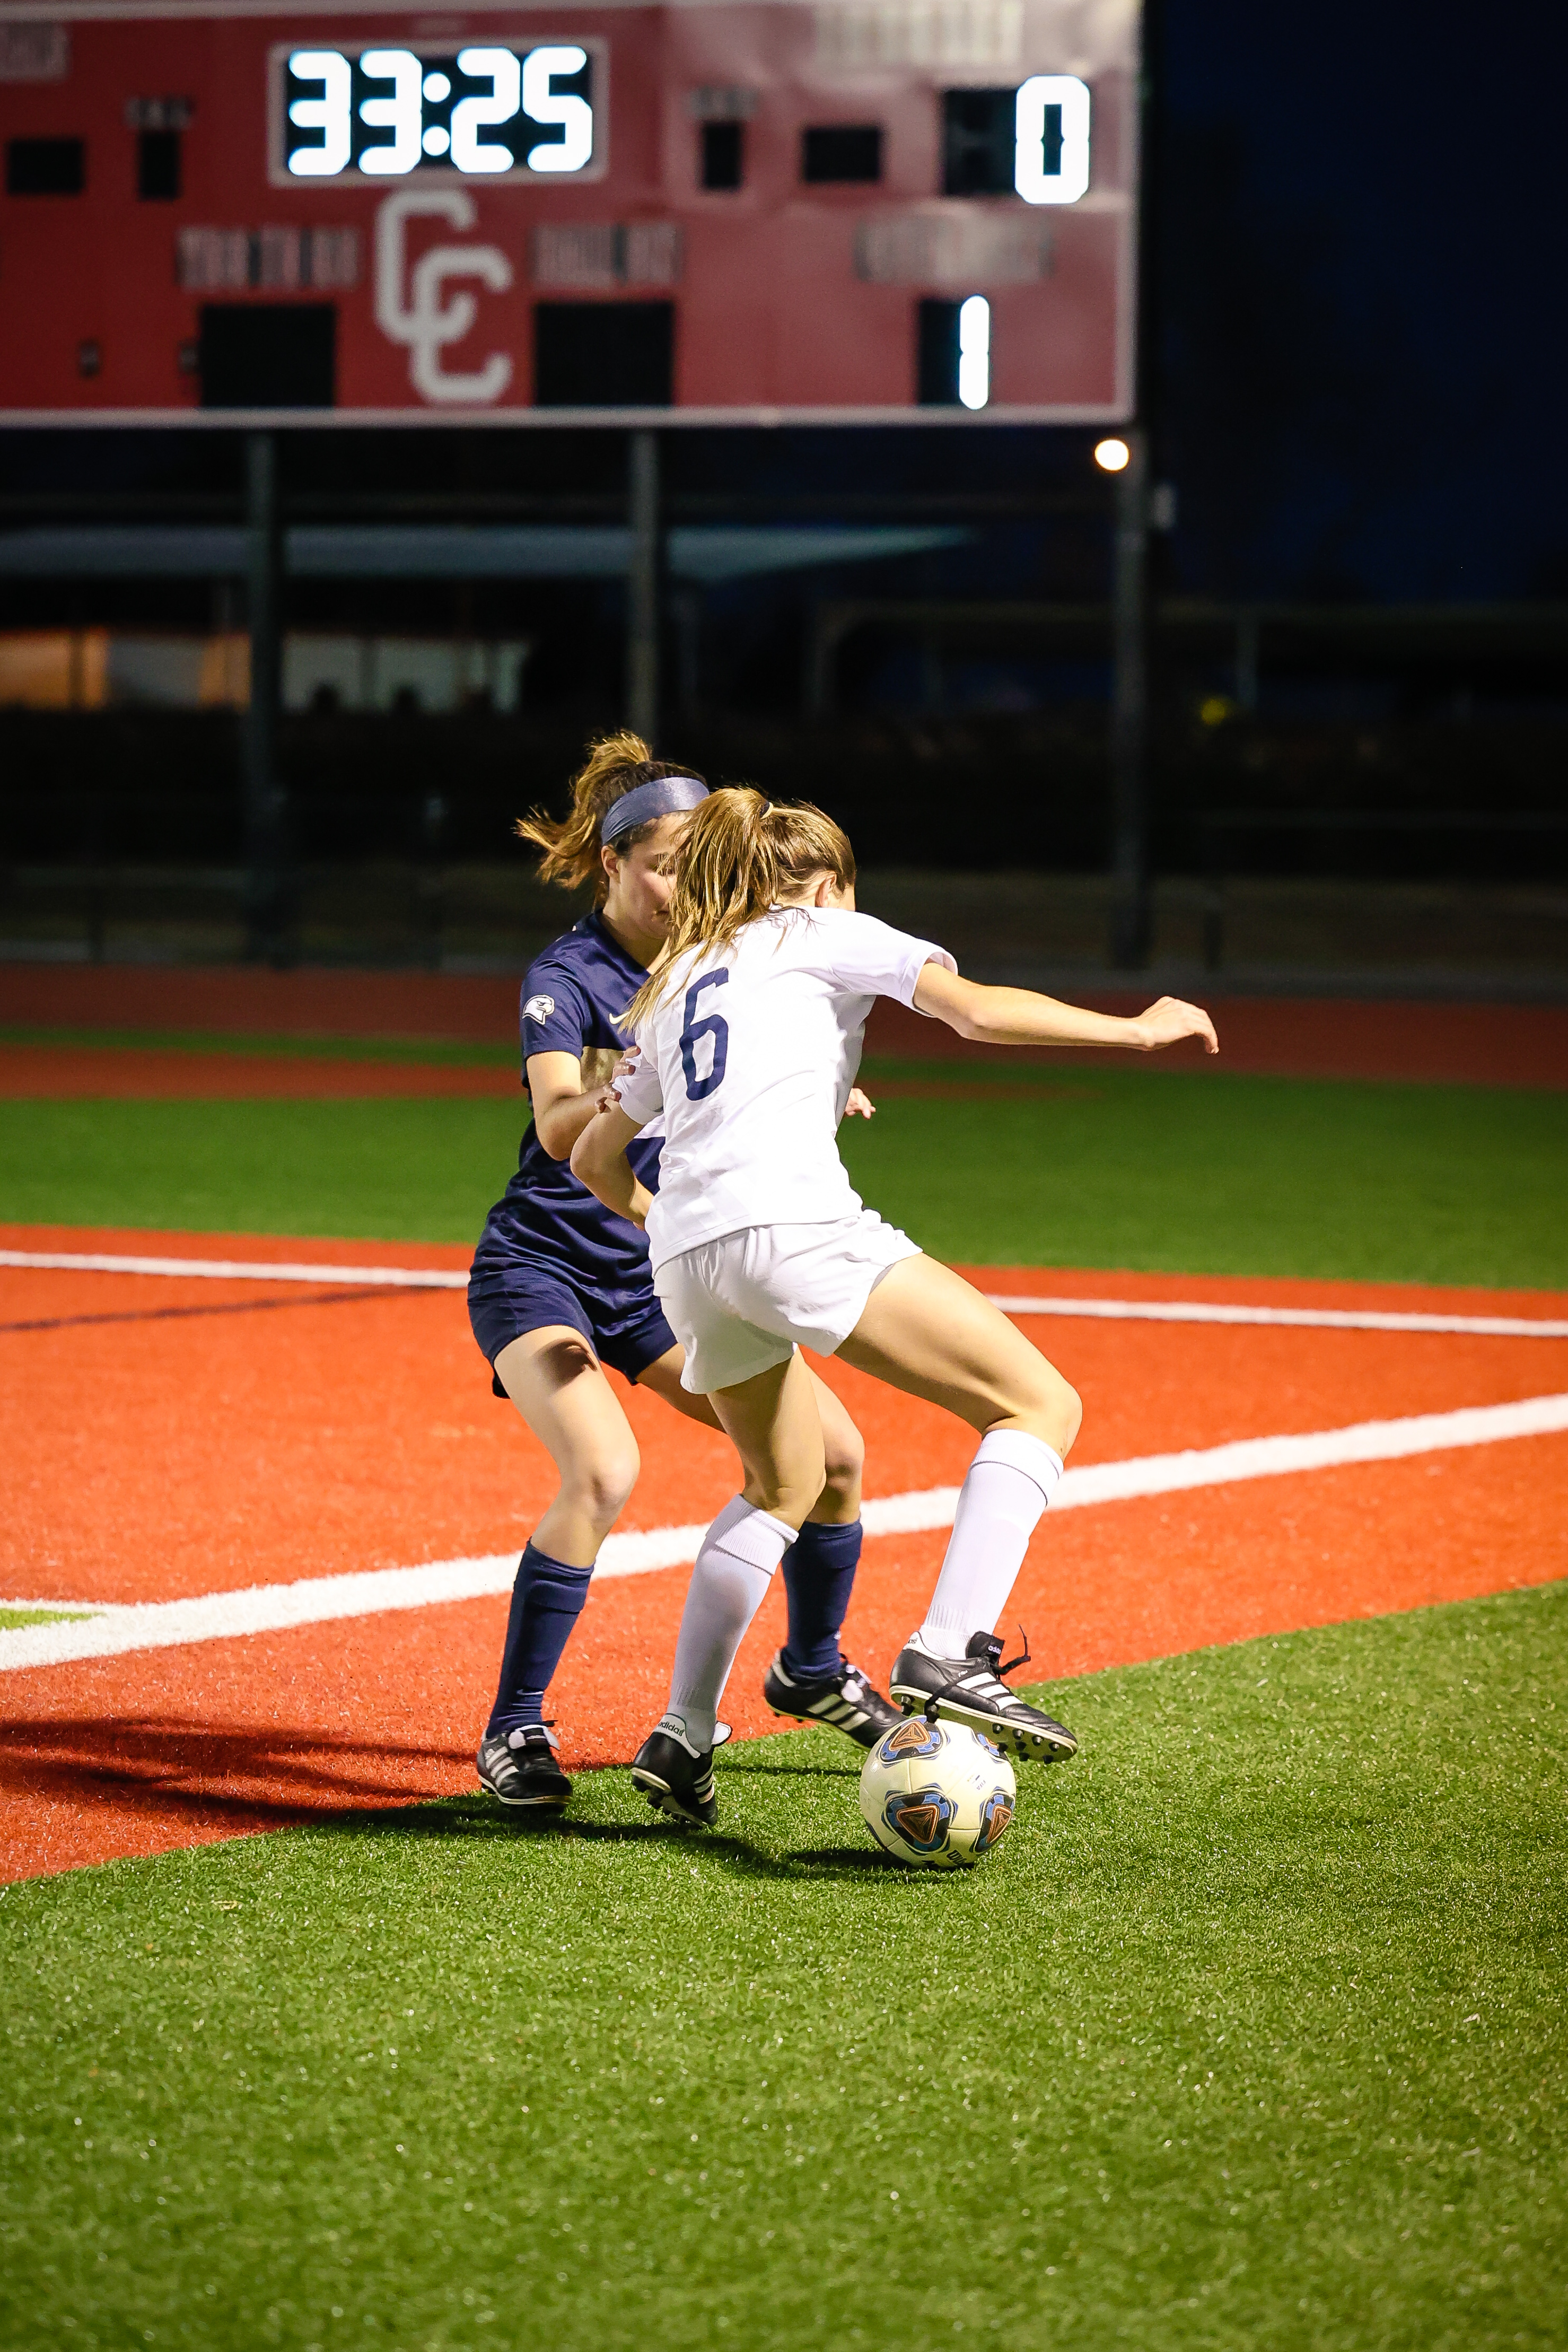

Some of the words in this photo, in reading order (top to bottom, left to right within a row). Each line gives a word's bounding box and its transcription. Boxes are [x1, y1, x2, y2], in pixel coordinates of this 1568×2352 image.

[288, 45, 593, 176] 33:25
[1015, 74, 1091, 204] 0
[959, 295, 990, 410] 1
[679, 967, 729, 1101] 6
